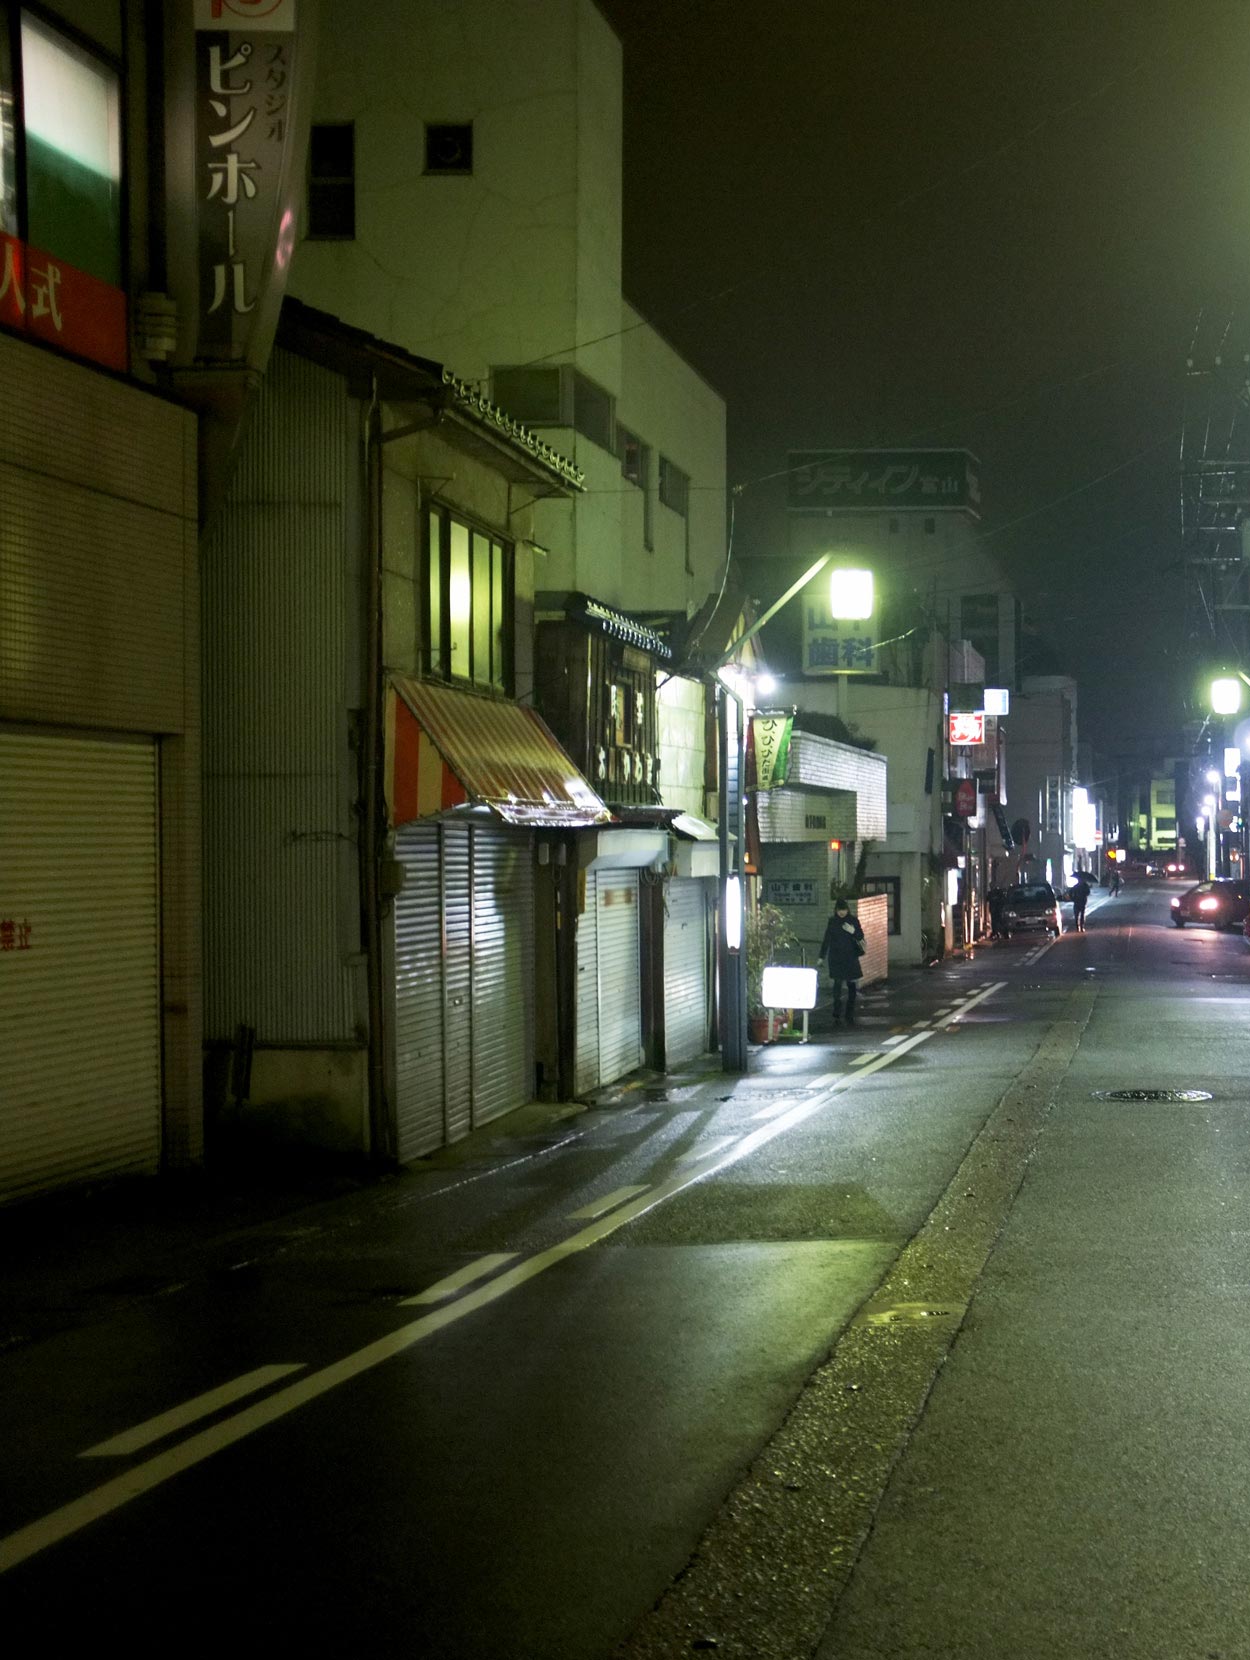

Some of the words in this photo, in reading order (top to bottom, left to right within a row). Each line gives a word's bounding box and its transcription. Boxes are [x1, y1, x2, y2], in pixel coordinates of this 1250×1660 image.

[206, 43, 261, 314] ピンホール
